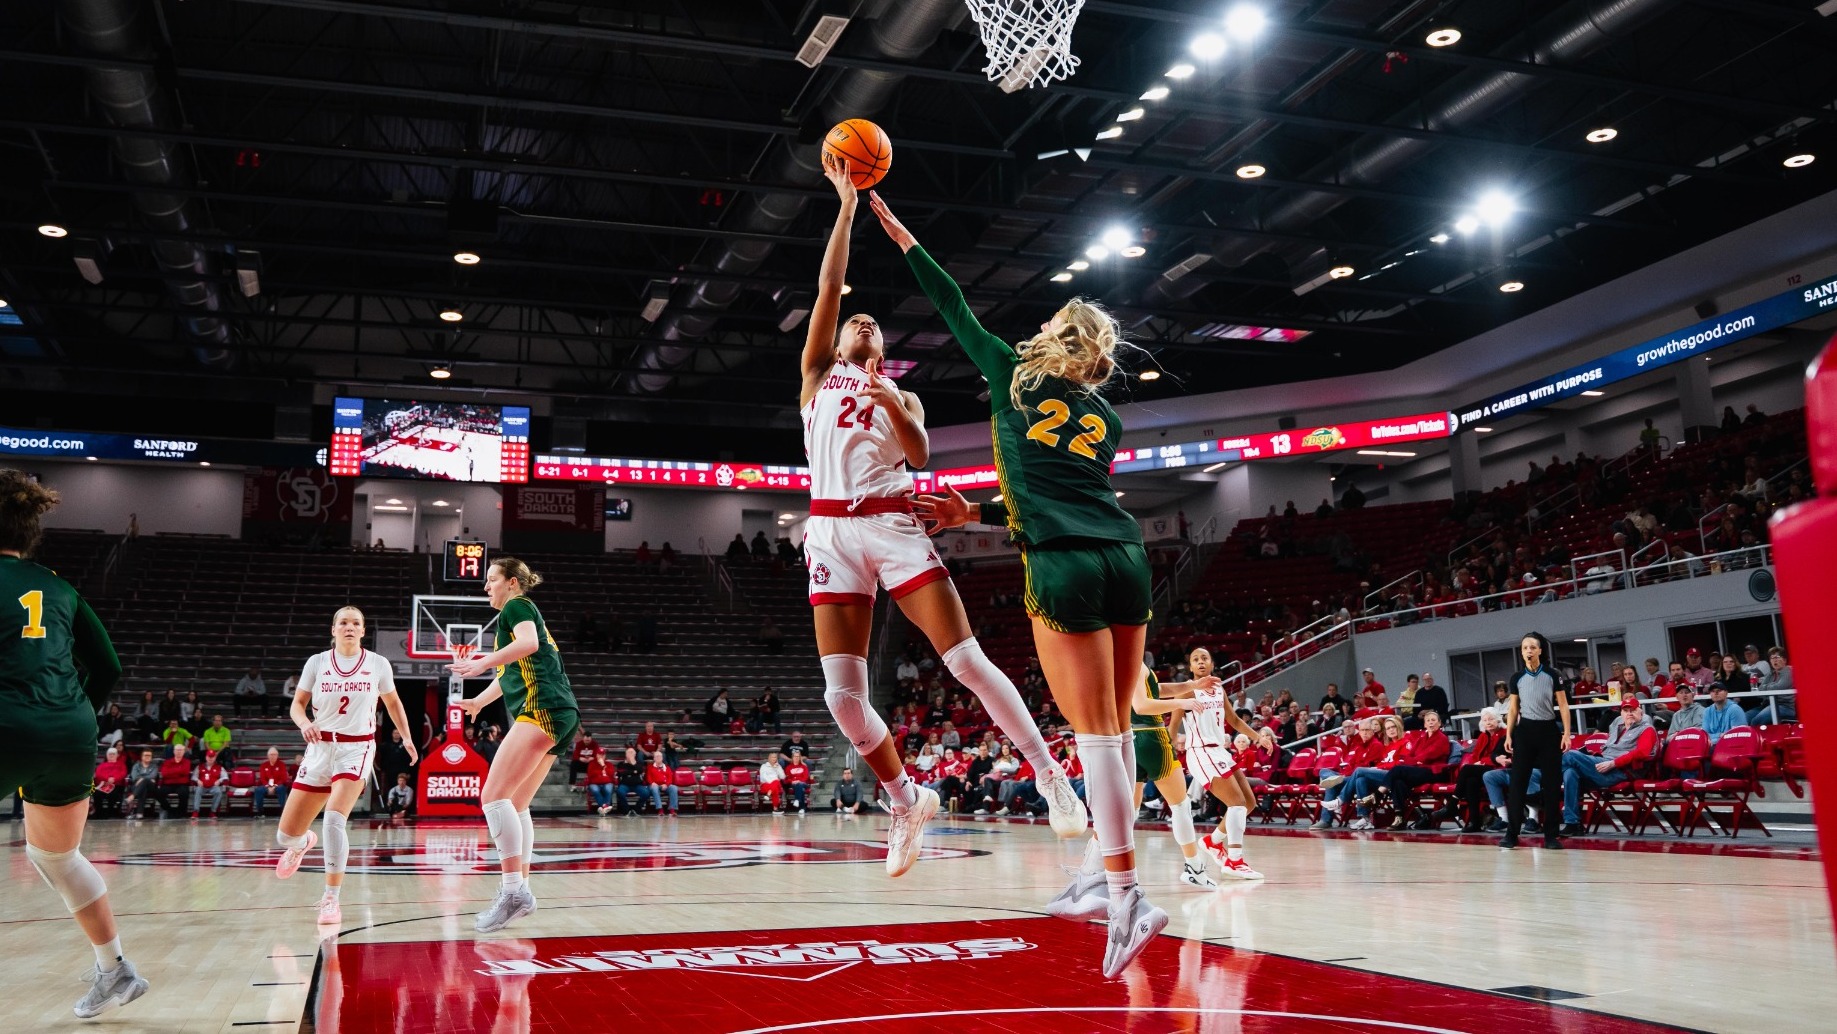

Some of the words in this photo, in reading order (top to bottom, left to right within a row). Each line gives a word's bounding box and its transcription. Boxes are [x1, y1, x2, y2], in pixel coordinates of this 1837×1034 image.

[1636, 313, 1755, 367] growthegood.com
[1461, 409, 1482, 424] FIND
[1483, 404, 1491, 417] A
[1491, 393, 1528, 414] CAREER
[1528, 384, 1555, 402] WITH
[1555, 367, 1603, 392] PURPOSE
[836, 396, 875, 431] 24
[1026, 398, 1107, 461] 22
[134, 439, 195, 451] SANFORD
[1269, 435, 1291, 455] 13
[1302, 435, 1331, 448] NDSU
[145, 450, 184, 458] HEALTH
[538, 466, 560, 476] 6-21
[572, 468, 588, 477] 0-1
[603, 469, 619, 478] 4-4
[630, 470, 642, 480] 13
[650, 471, 655, 480] 1
[663, 472, 671, 481] 4
[680, 472, 686, 481] 1
[698, 473, 705, 483] 2
[768, 477, 789, 486] 6-15
[921, 482, 927, 491] 5
[524, 492, 576, 504] SOUTH
[524, 504, 576, 514] DAKOTA
[456, 545, 482, 557] 8:06
[460, 558, 478, 577] 17
[18, 590, 46, 638] 1
[321, 682, 342, 692] SOUTH
[344, 682, 371, 692] DAKOTA
[338, 696, 350, 714] 2
[427, 776, 480, 788] SOUTH
[427, 787, 480, 798] DAKOTA
